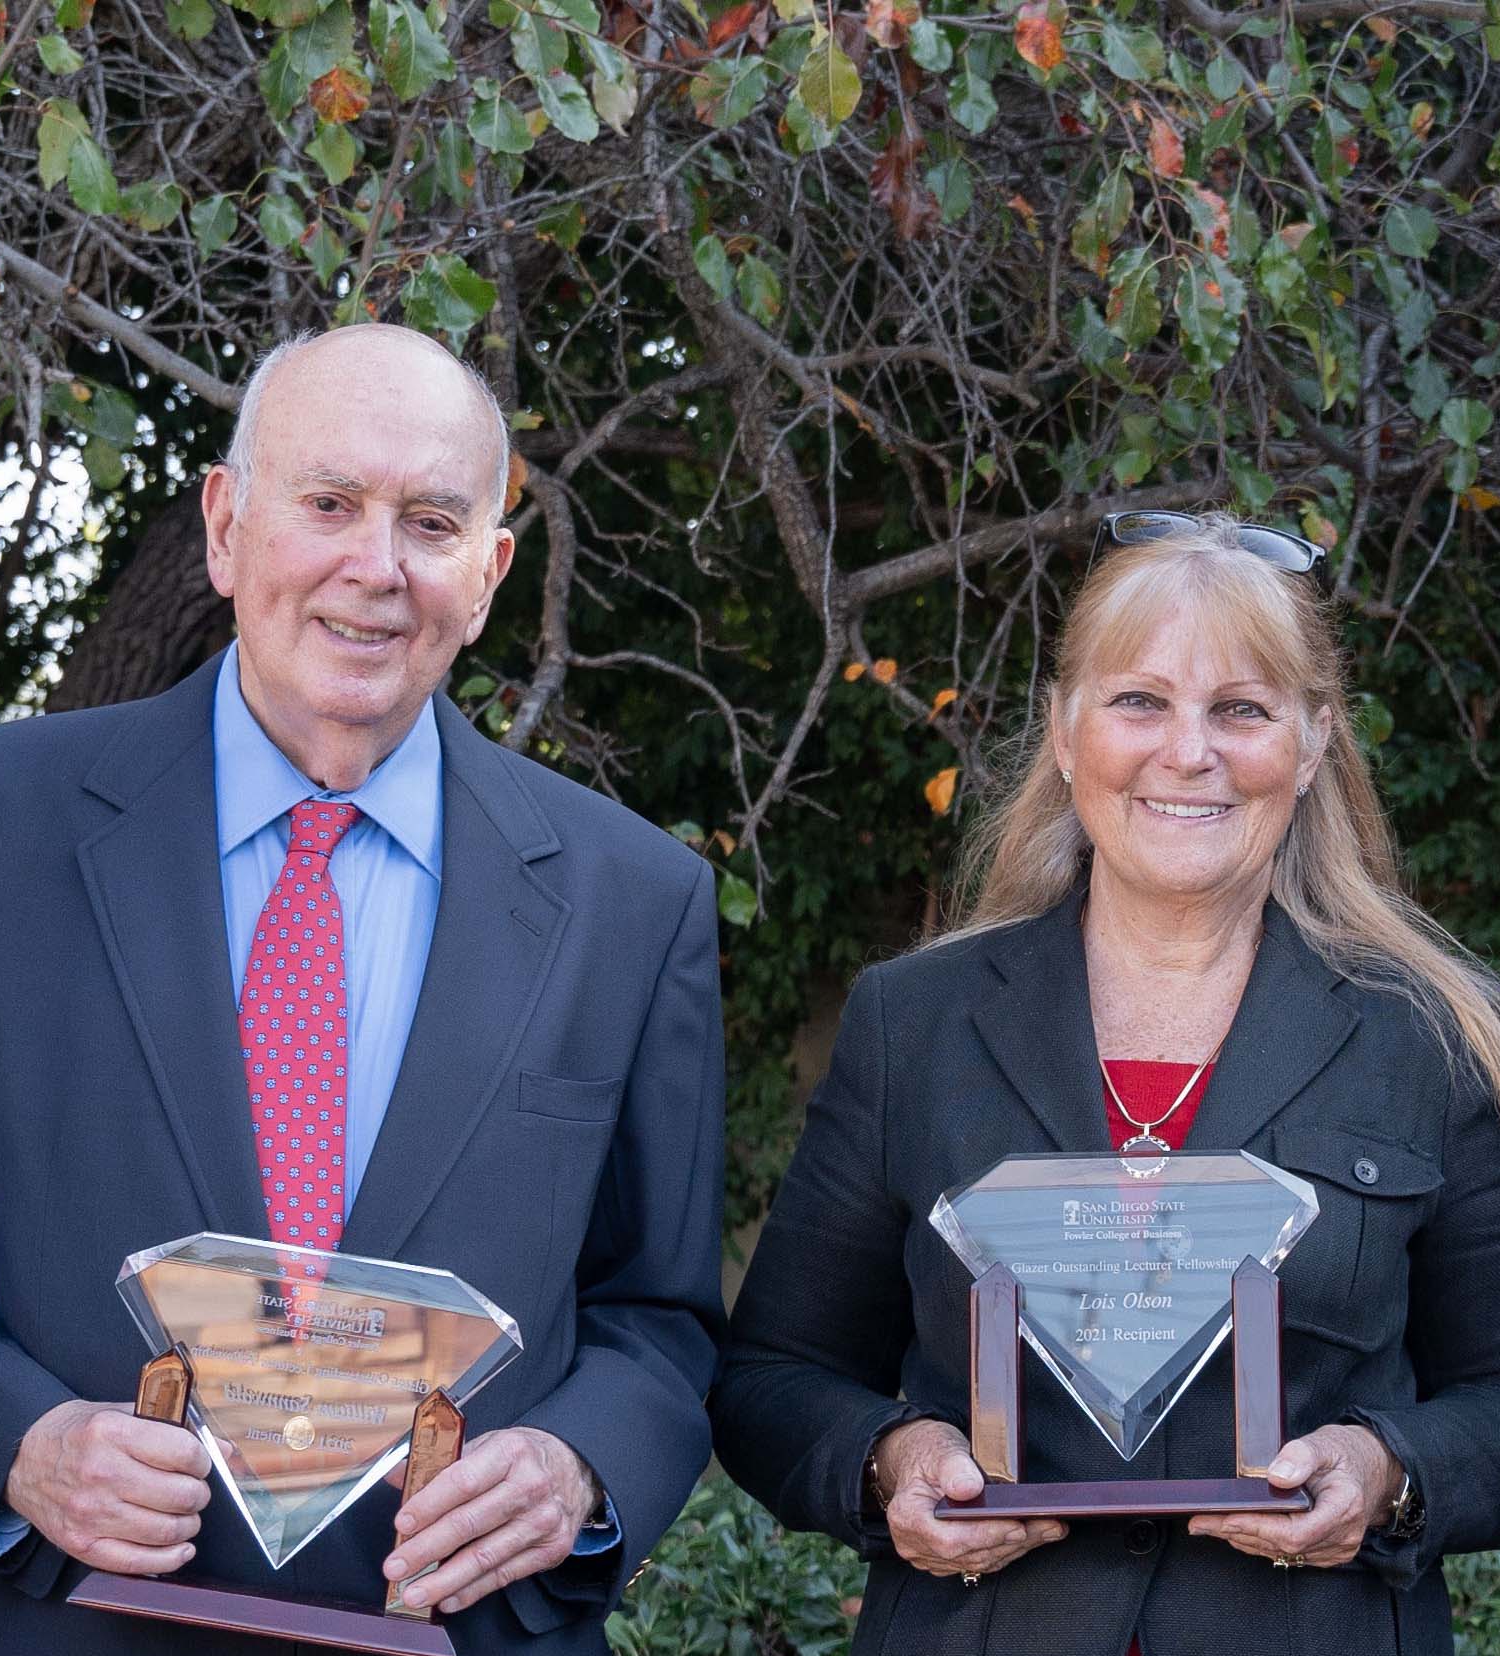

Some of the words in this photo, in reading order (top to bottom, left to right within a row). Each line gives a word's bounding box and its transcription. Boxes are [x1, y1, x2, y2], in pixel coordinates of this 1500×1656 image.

[1082, 1201, 1106, 1213] SAN
[1111, 1200, 1150, 1212] DIEGO
[1151, 1200, 1187, 1212] STATE
[1082, 1214, 1157, 1225] UNIVERSITY
[1064, 1231, 1094, 1240] Fowler
[1095, 1230, 1129, 1241] College
[1130, 1229, 1140, 1239] of
[1143, 1229, 1182, 1239] Business
[1011, 1261, 1049, 1274] Glazer
[1052, 1260, 1121, 1274] Outstanding
[1124, 1258, 1173, 1272] Lecturer
[1177, 1257, 1240, 1272] Fellowship
[1079, 1292, 1117, 1310] Lois
[1122, 1291, 1173, 1309] Olson
[1075, 1328, 1107, 1342] 2021
[1113, 1326, 1175, 1343] Recipient
